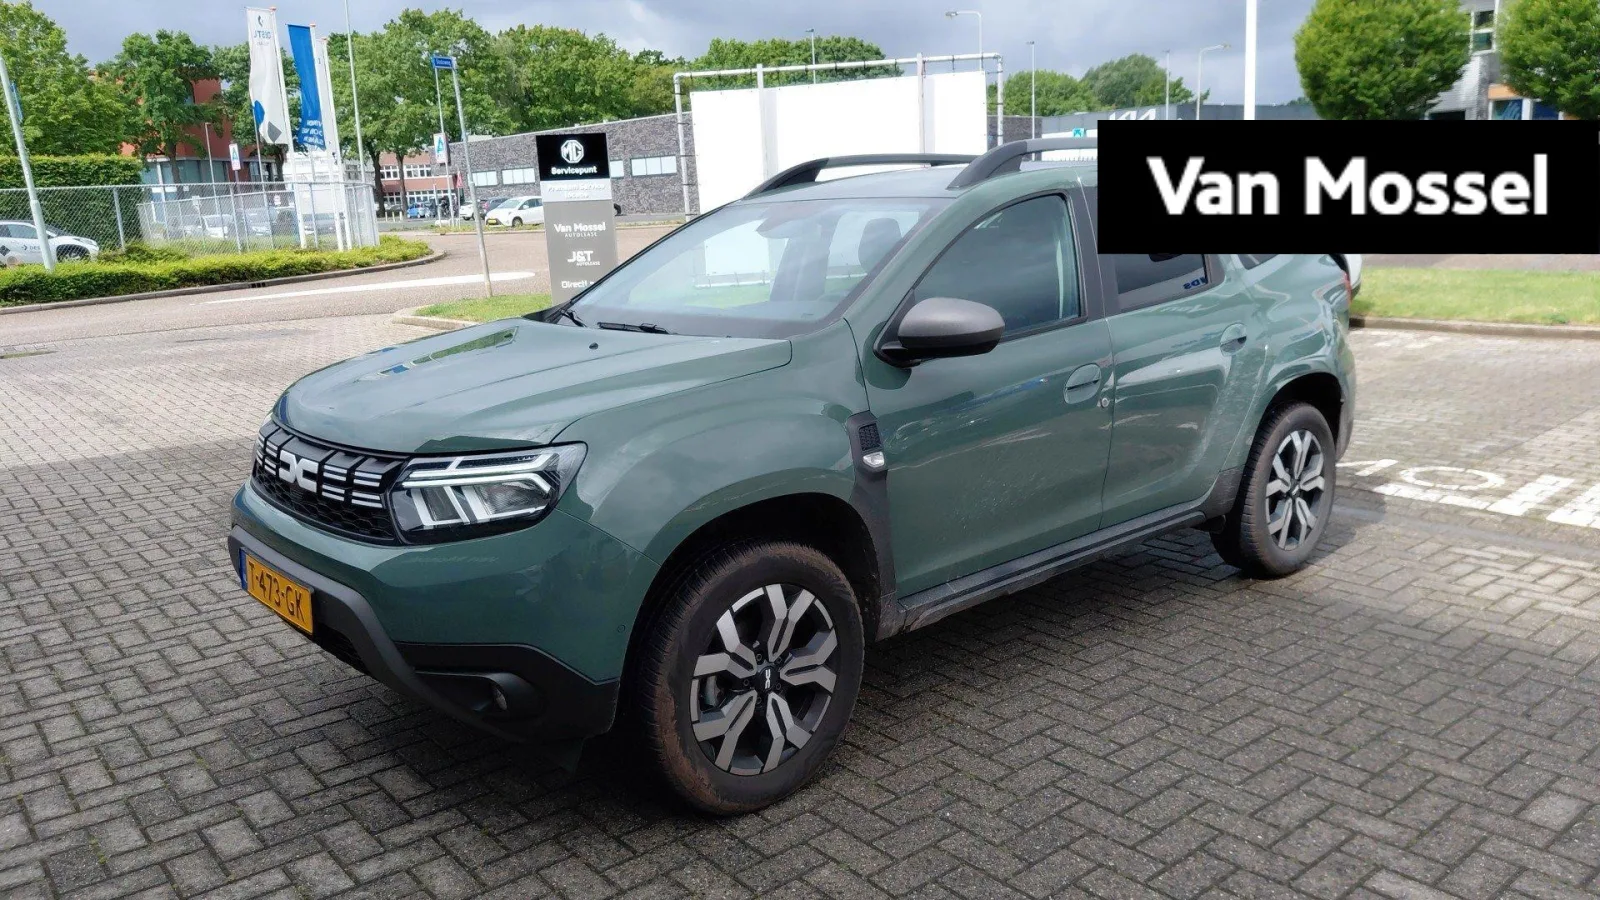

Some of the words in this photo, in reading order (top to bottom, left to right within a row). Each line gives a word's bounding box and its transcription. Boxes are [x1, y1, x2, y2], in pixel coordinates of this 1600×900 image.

[561, 140, 584, 163] MG
[551, 166, 598, 175] Servicepunt
[554, 223, 572, 233] Van
[573, 221, 606, 232] Mossel
[567, 250, 594, 262] J&T
[248, 561, 306, 625] T-473-GK
